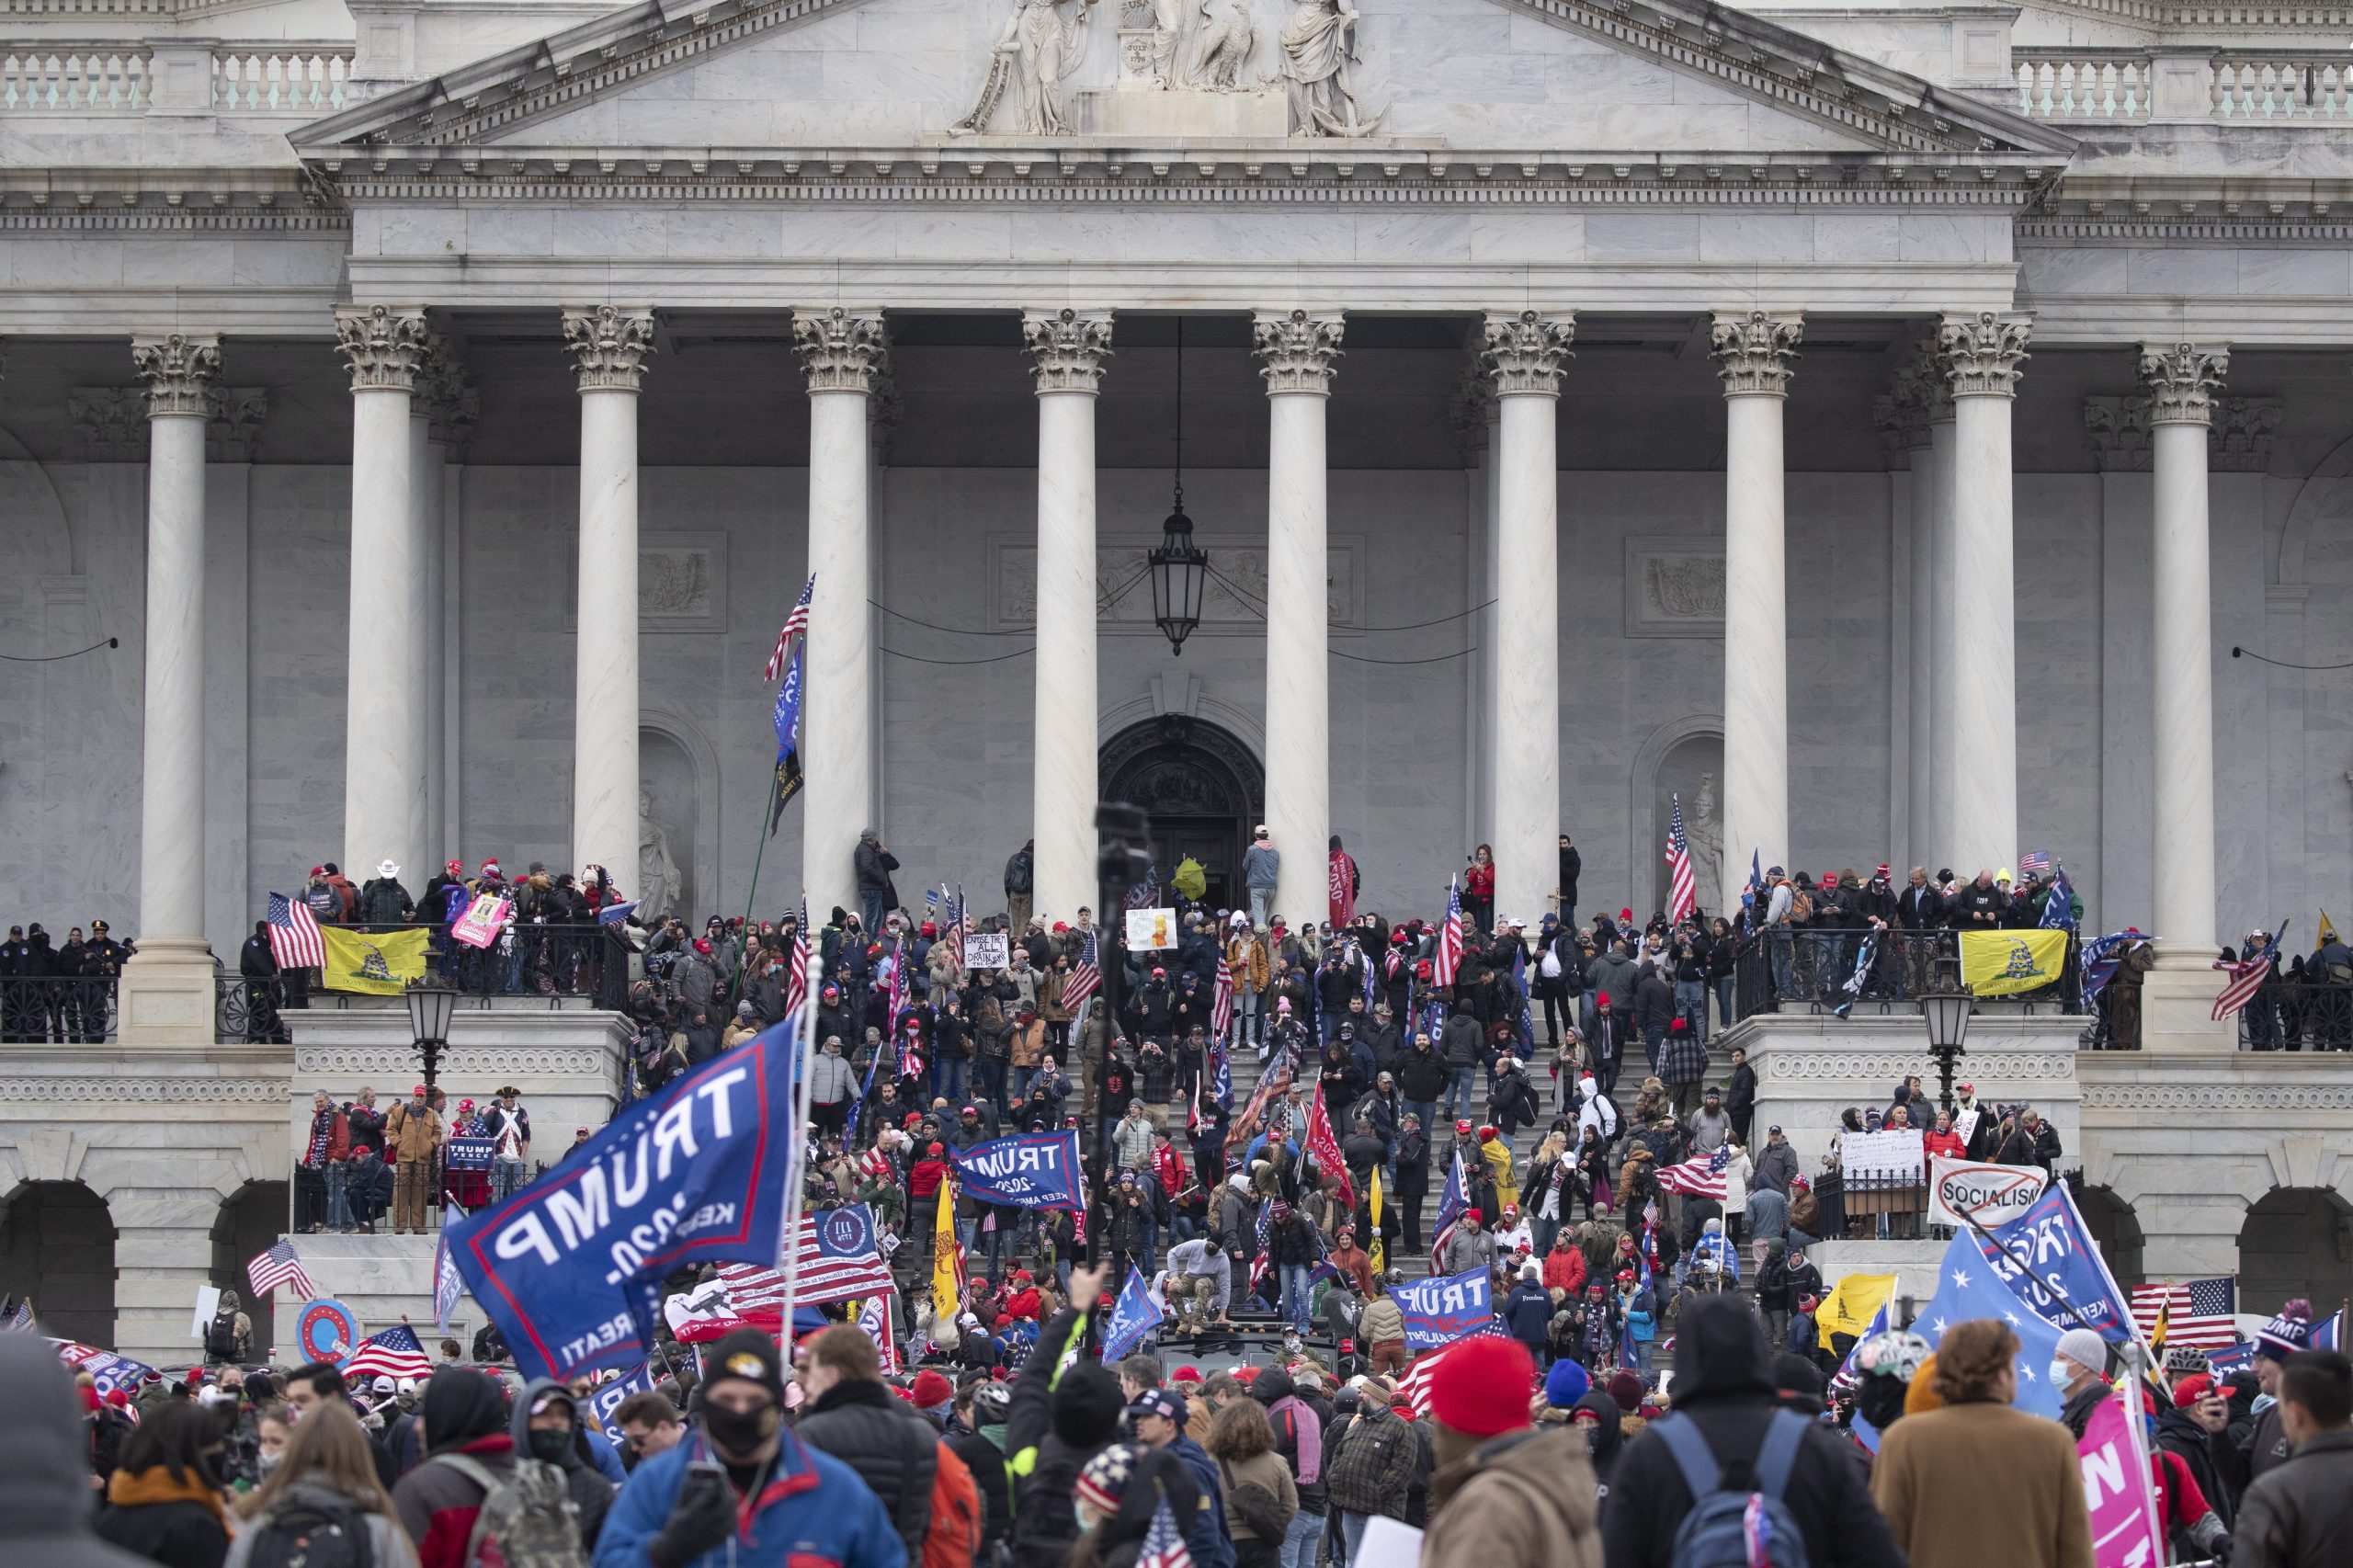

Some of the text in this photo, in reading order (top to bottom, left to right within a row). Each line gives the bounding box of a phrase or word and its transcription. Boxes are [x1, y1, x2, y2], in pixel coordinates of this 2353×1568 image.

[460, 923, 486, 937] Latinos
[966, 936, 989, 944] EXPOSE
[968, 953, 991, 962] DRAIN
[986, 951, 1006, 967] SWAMP
[364, 980, 388, 989] TREAD
[2010, 979, 2031, 988] TREAD
[1963, 1116, 1975, 1140] STEAL
[449, 1145, 494, 1153] TRUMP
[1522, 1293, 1544, 1301] Freedom
[2264, 1319, 2305, 1340] UMP
